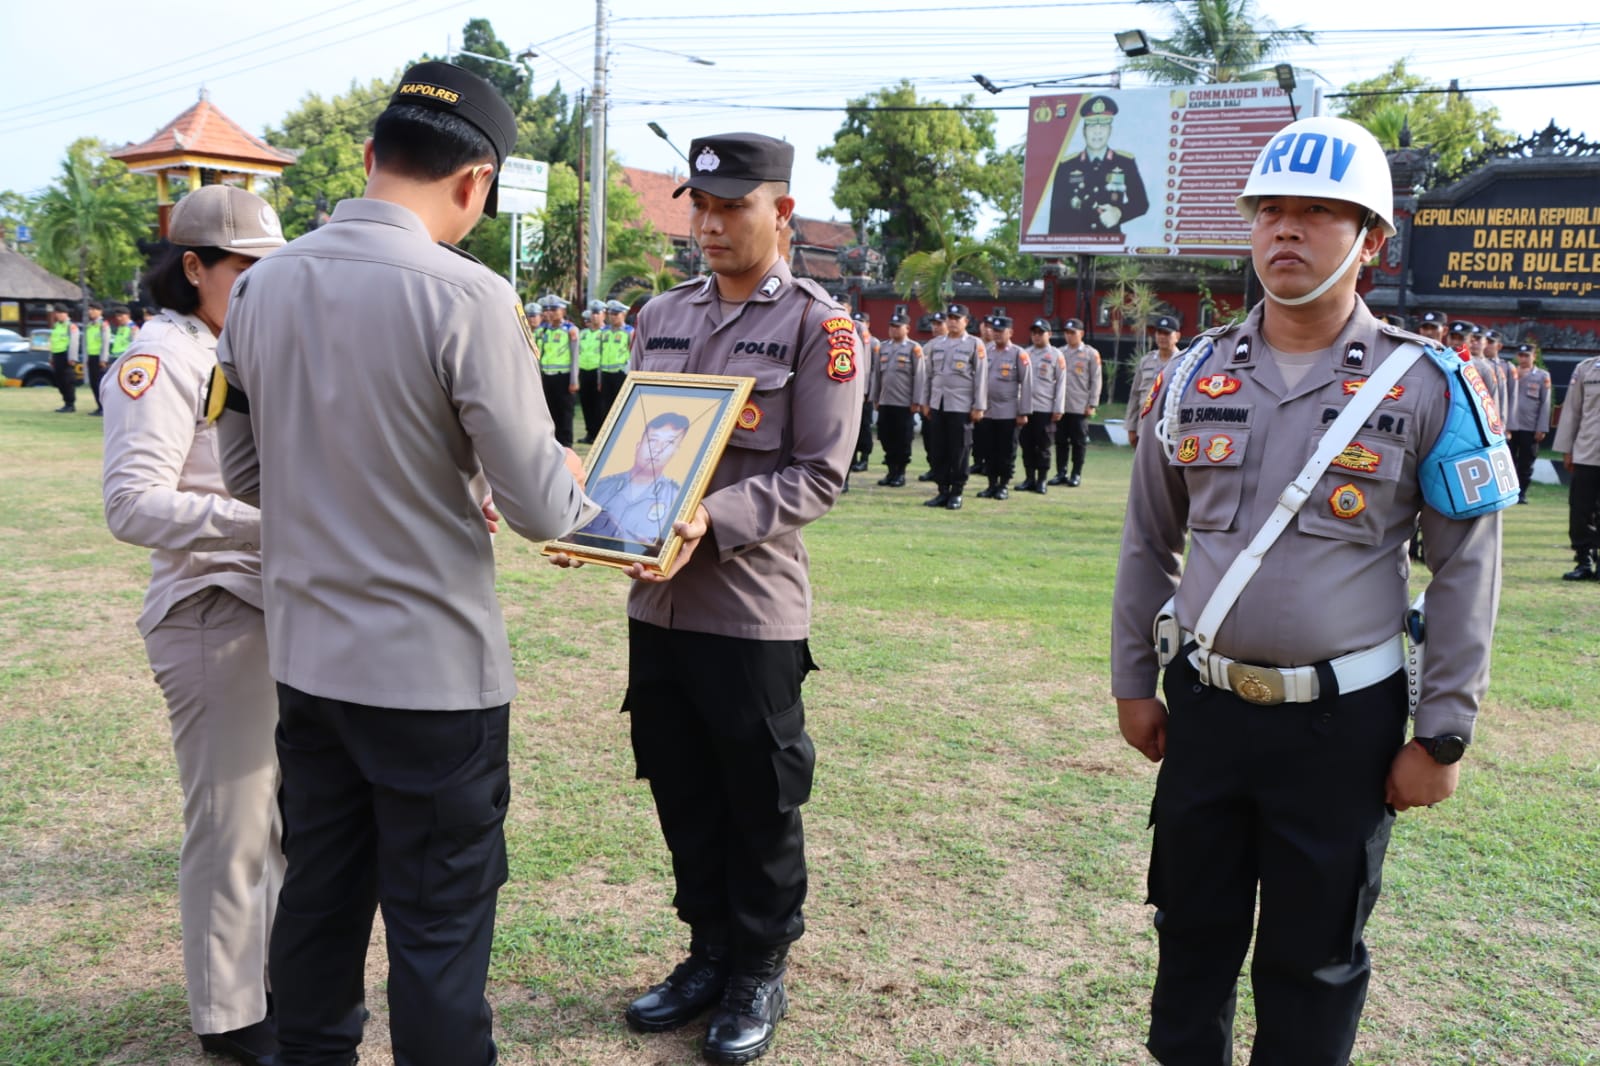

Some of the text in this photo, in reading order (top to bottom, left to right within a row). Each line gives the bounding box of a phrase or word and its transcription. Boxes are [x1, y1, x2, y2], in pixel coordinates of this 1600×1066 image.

[400, 84, 460, 103] KAPOLRES
[1189, 88, 1258, 101] COMMANDER
[1414, 208, 1485, 226] KEPOLISIAN
[1487, 208, 1536, 226] NEGARA
[1473, 229, 1553, 249] DAERAH
[1448, 252, 1514, 271] RESOR
[733, 341, 788, 360] POLRI
[1455, 450, 1519, 505] PR
